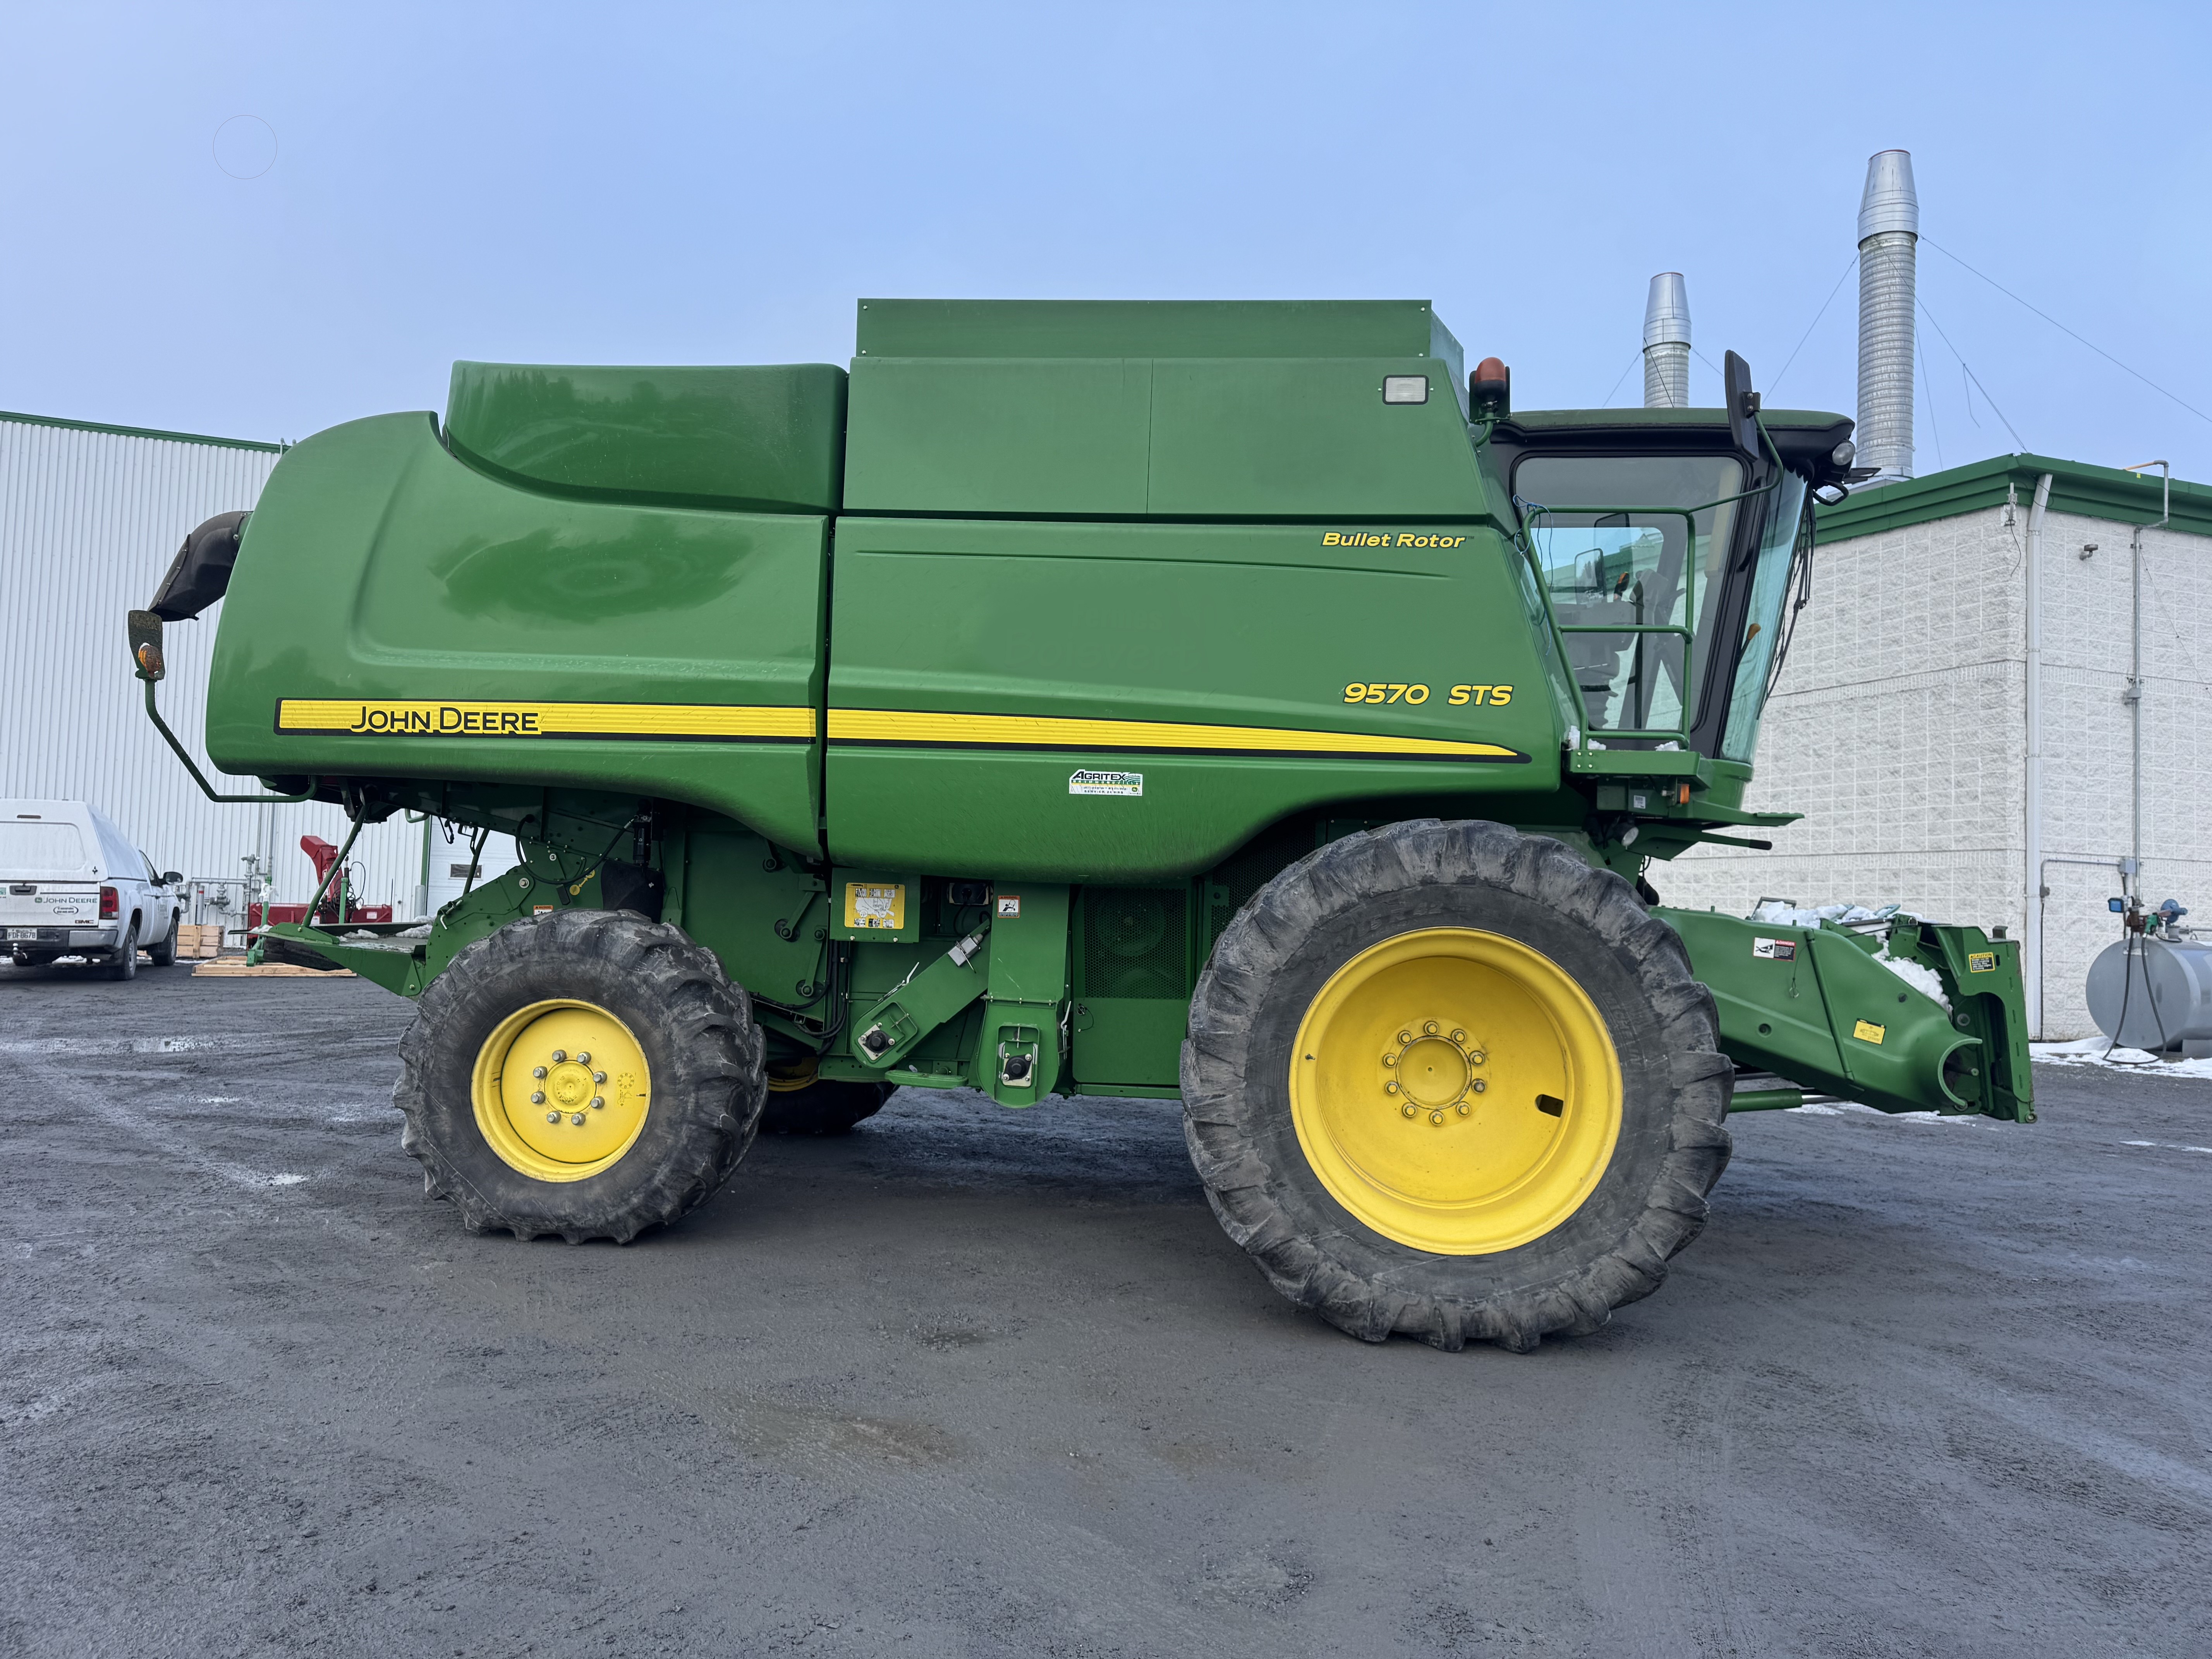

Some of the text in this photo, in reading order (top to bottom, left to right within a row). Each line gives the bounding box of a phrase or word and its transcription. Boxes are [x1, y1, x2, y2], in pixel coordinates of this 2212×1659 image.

[1322, 532, 1391, 547] Bullet
[1396, 534, 1465, 548] Rotor
[1344, 683, 1513, 706] 9570 STS
[351, 706, 539, 731] JOHN DEERE
[1072, 771, 1126, 781] AGRITEX
